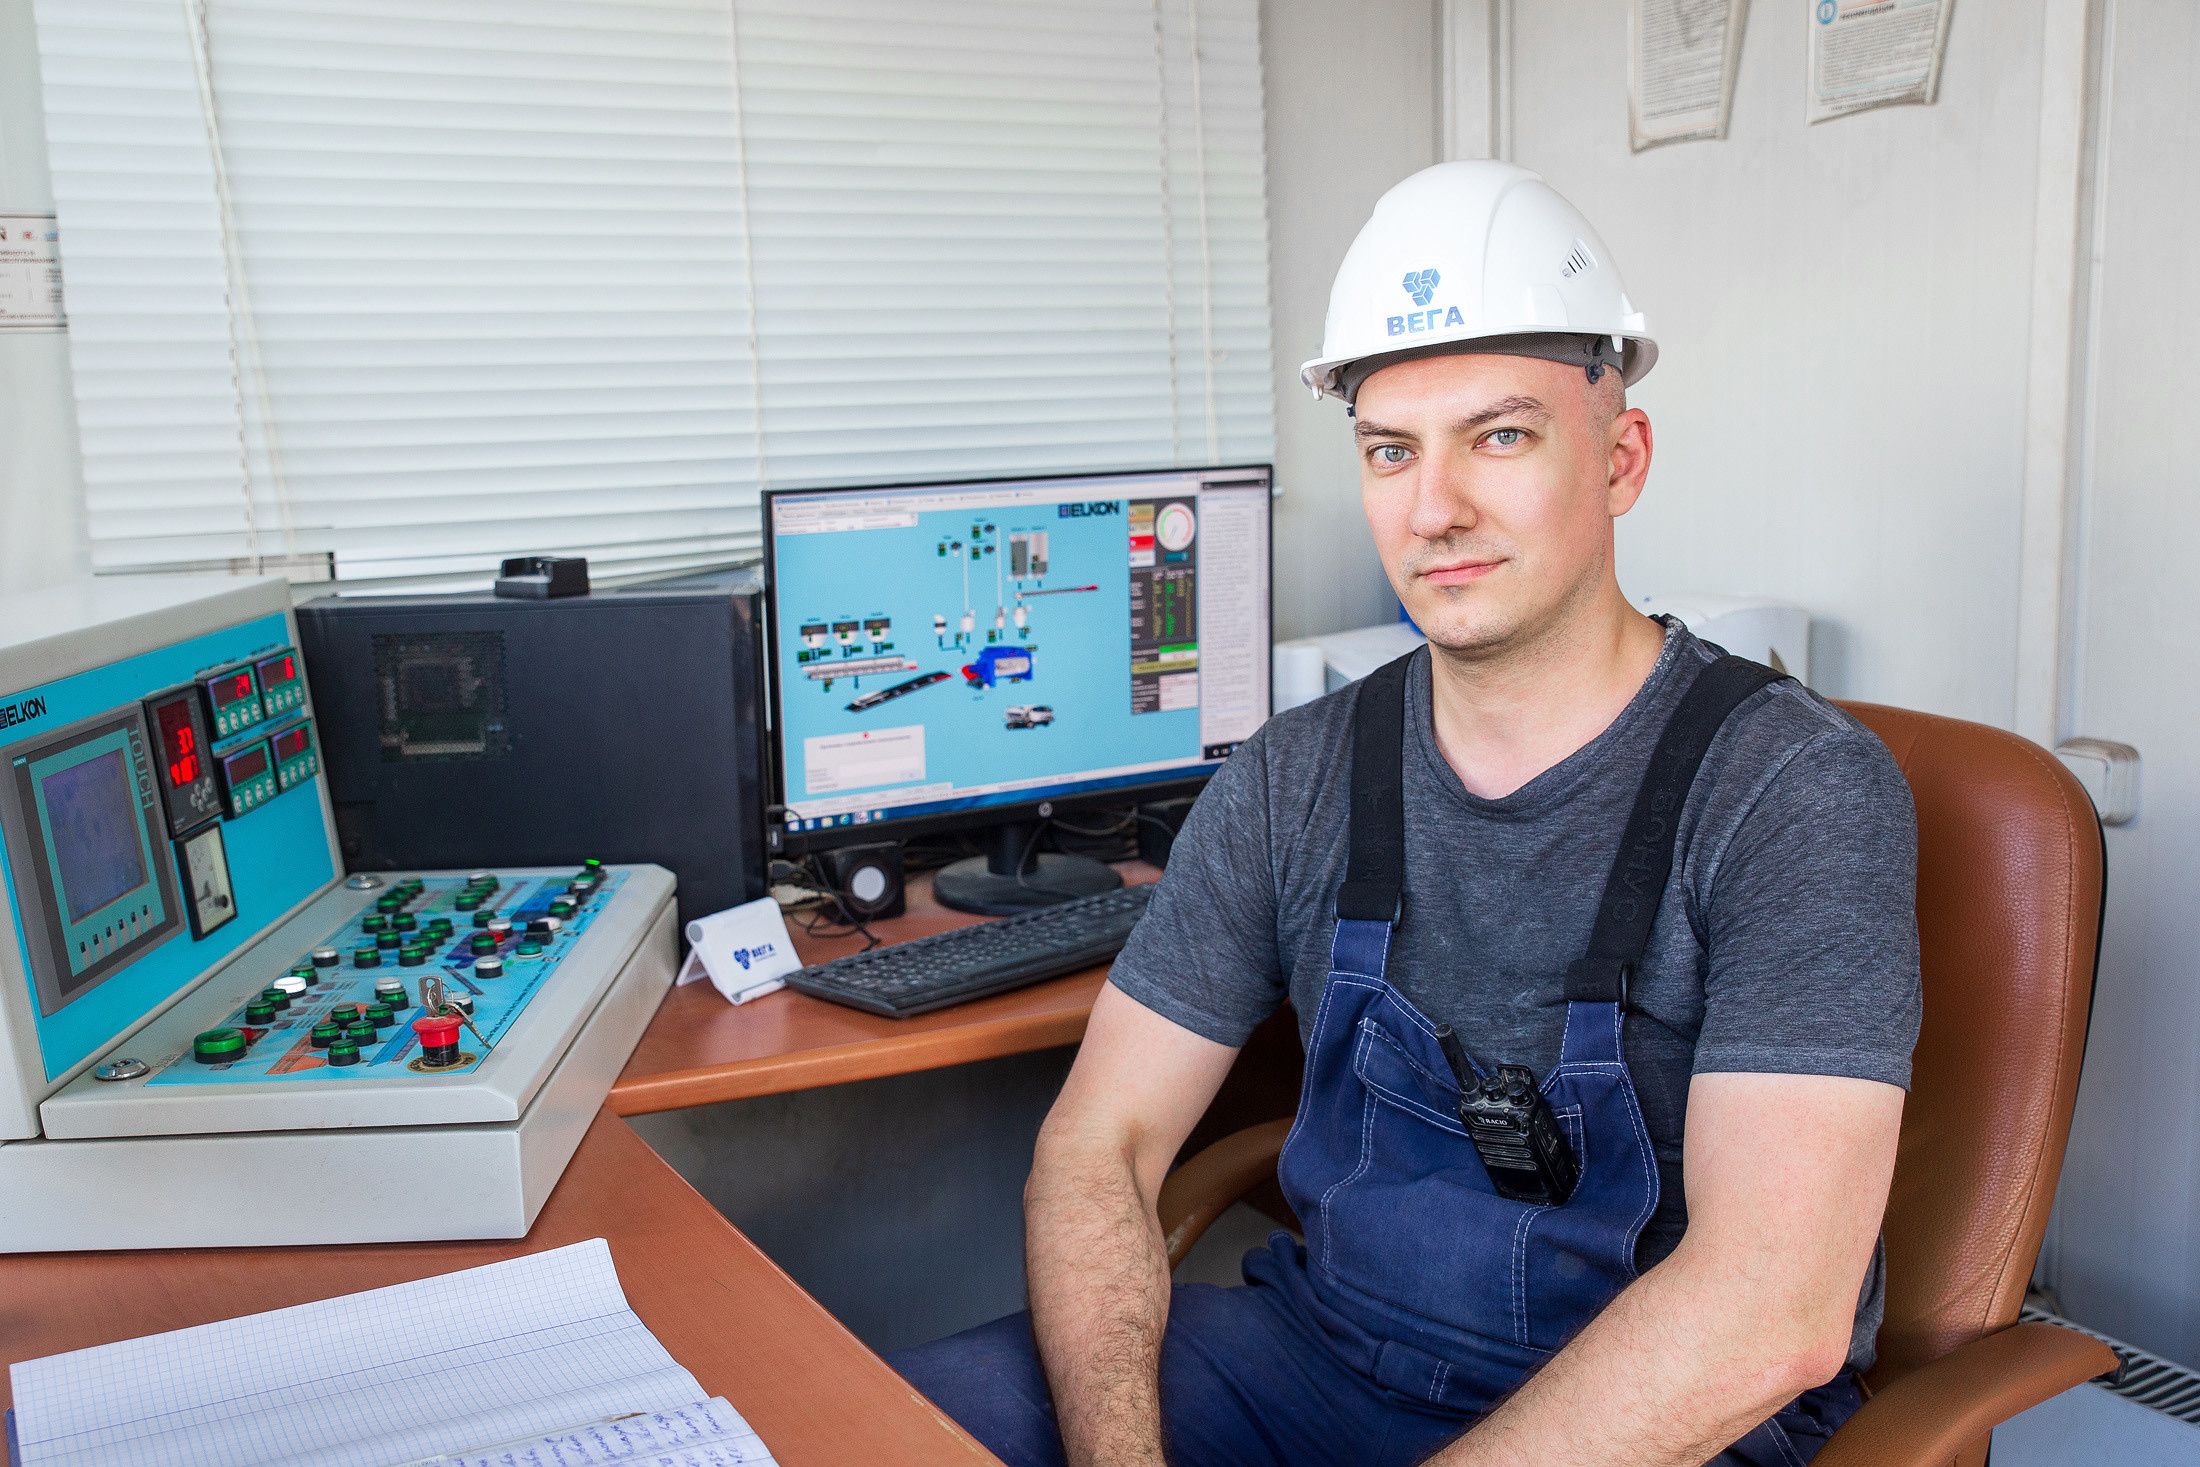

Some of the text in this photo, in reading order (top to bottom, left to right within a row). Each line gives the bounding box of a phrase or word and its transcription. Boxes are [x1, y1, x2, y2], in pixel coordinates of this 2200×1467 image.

[1387, 306, 1465, 336] ВЕГА
[1070, 502, 1119, 517] ELKON
[5, 696, 47, 727] ELKON
[128, 722, 154, 809] TOUCH
